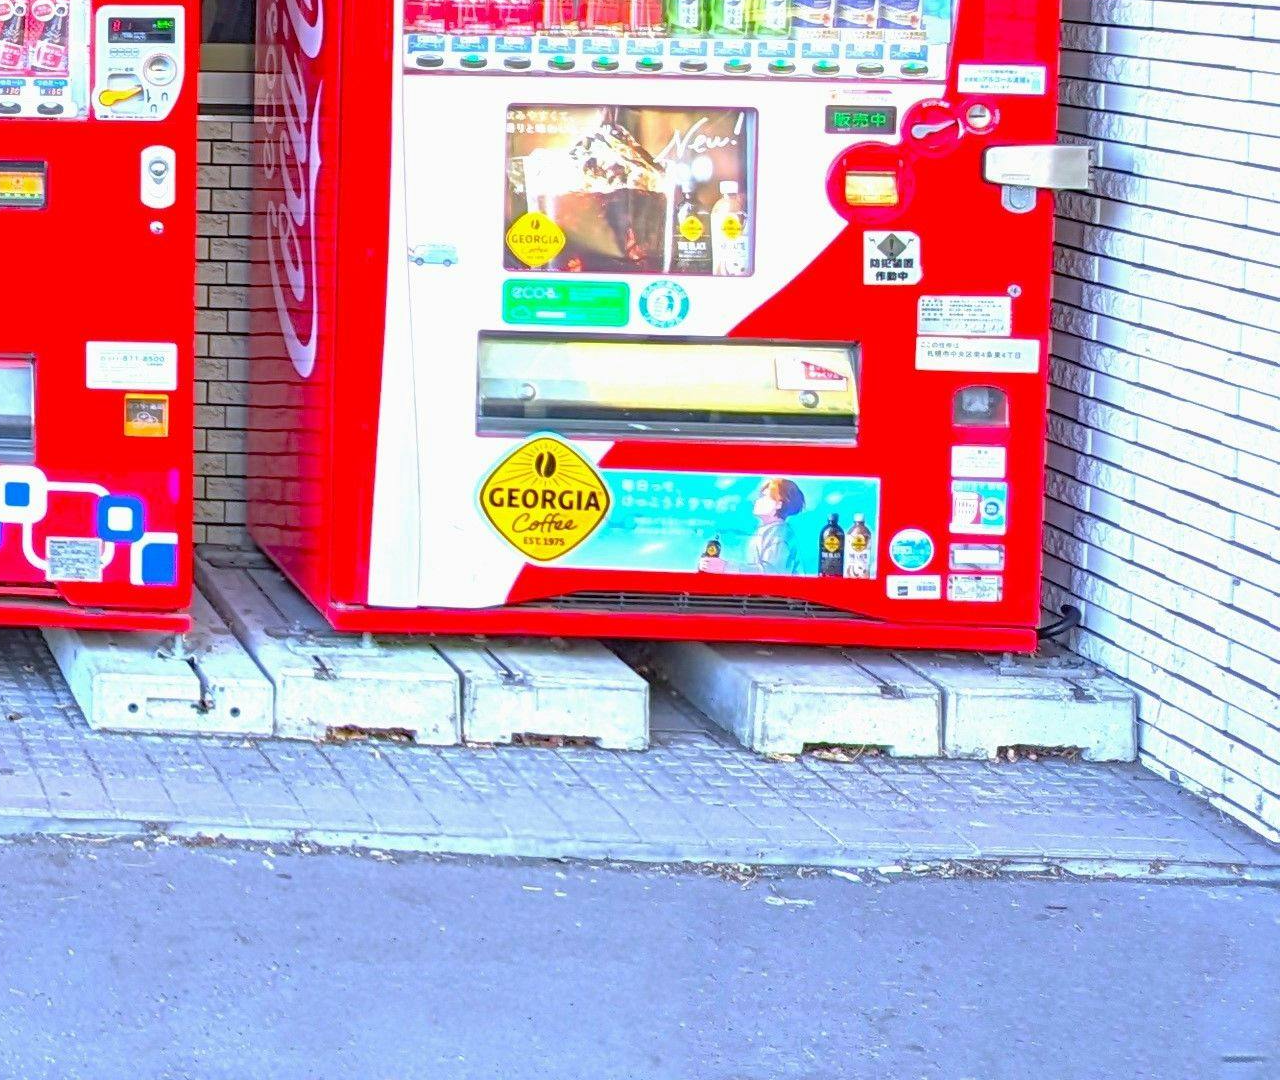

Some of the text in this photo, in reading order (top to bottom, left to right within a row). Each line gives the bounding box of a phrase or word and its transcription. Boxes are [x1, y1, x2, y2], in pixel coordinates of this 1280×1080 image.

[834, 111, 887, 128] 販売中
[654, 111, 746, 162] New!
[511, 234, 560, 245] GEORGIA
[869, 258, 915, 268] 防犯装置
[875, 271, 909, 281] 作動中
[488, 486, 601, 512] GEORGIA
[511, 512, 578, 534] Coffee
[523, 536, 565, 547] EST. 1975
